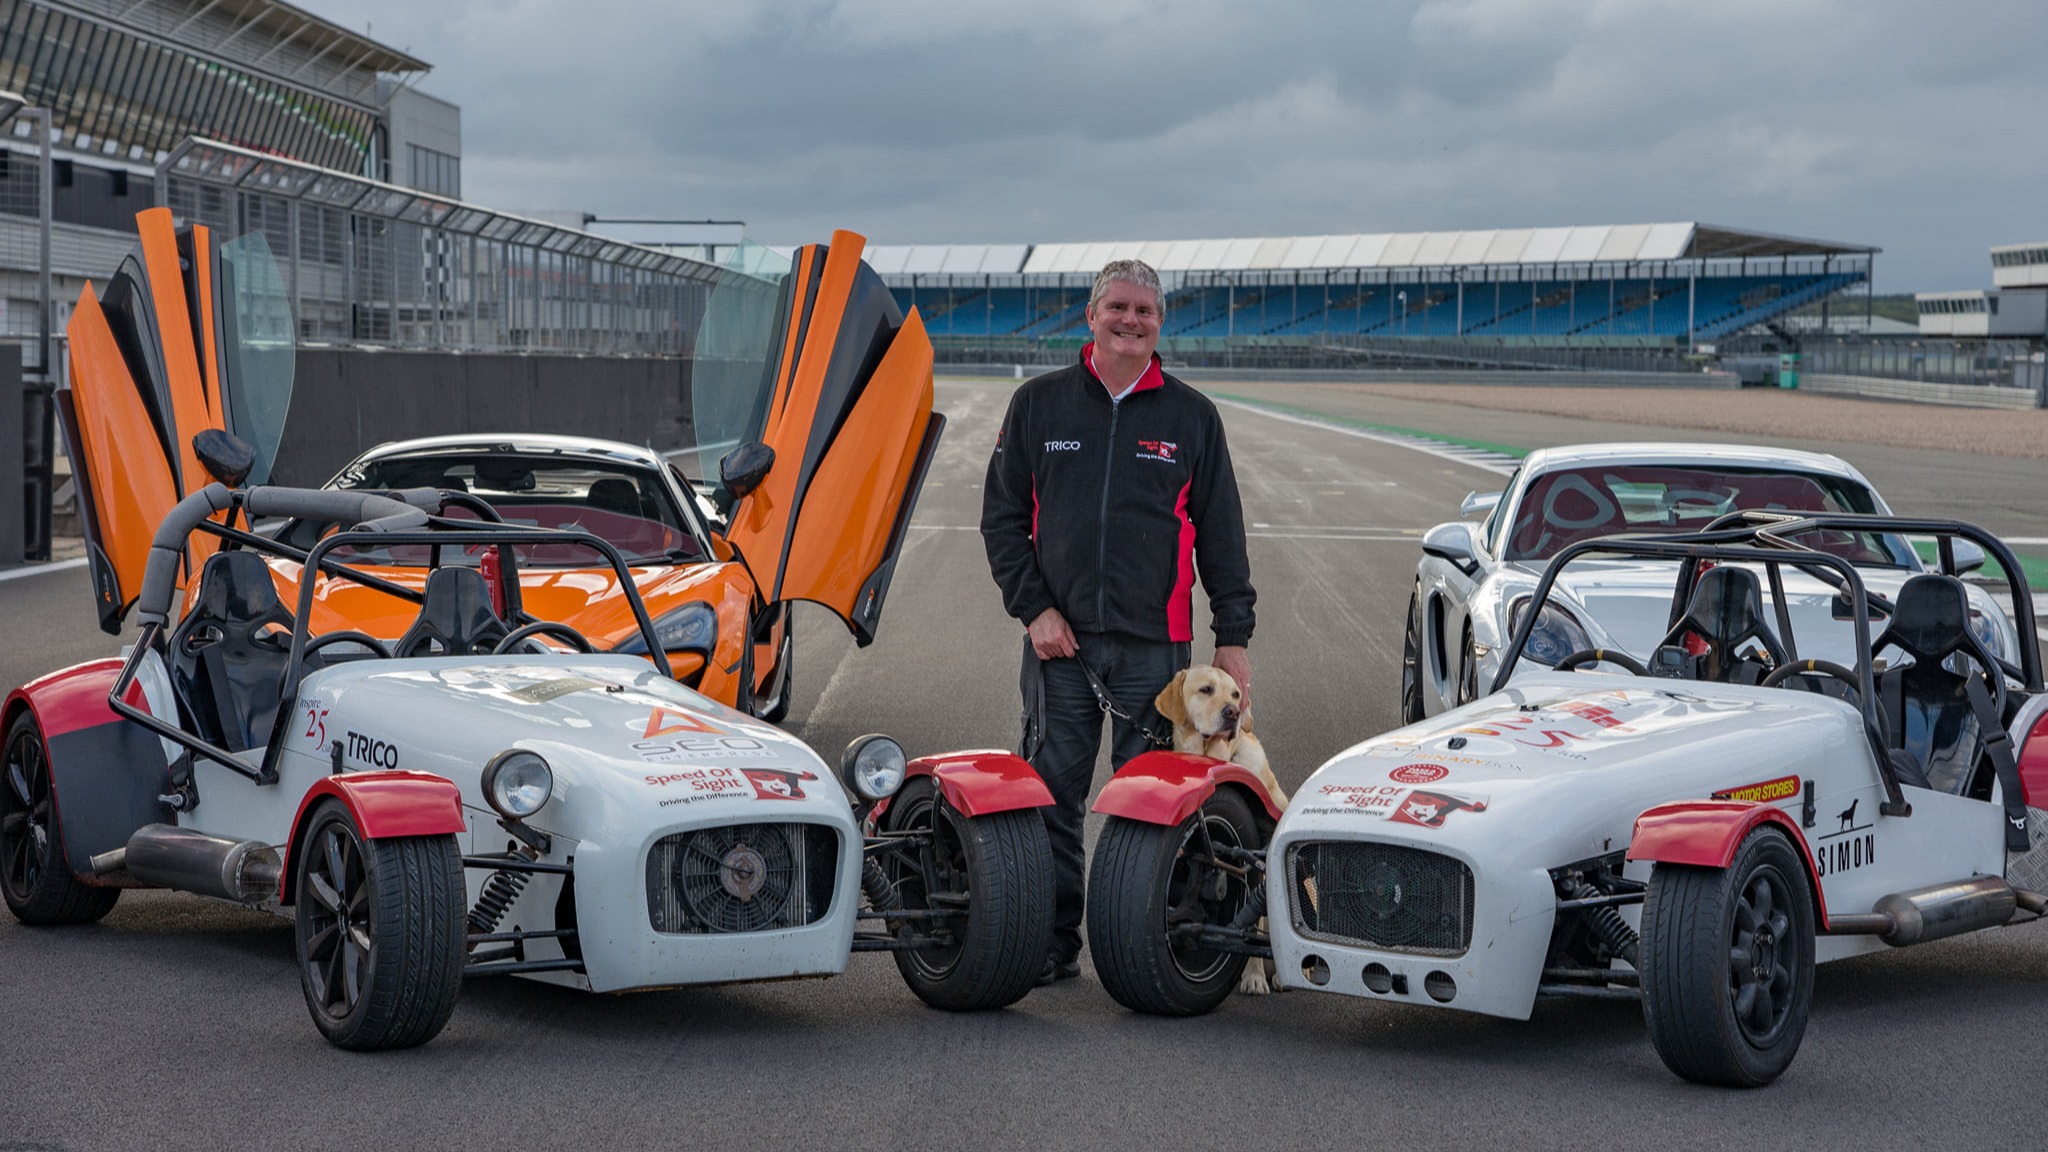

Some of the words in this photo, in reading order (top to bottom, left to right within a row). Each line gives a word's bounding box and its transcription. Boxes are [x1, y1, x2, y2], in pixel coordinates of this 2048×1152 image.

[1044, 440, 1081, 453] TRICO
[299, 697, 322, 711] Inspire
[305, 709, 329, 751] 25
[347, 730, 398, 770] TRICO
[632, 738, 764, 757] SEO
[645, 751, 779, 764] ENTERPRISE
[645, 772, 706, 787] Speed
[709, 767, 734, 779] Of
[691, 778, 743, 792] Sight
[1319, 784, 1376, 796] Speed
[1379, 786, 1405, 797] Of
[1731, 786, 1762, 802] MOTOR
[1761, 779, 1795, 800] STORES
[659, 796, 691, 808] Driving
[706, 791, 749, 800] Difference
[1343, 794, 1395, 808] Sight
[1302, 807, 1330, 817] Driving
[1343, 807, 1385, 817] Difference
[1818, 834, 1875, 878] SIMON
